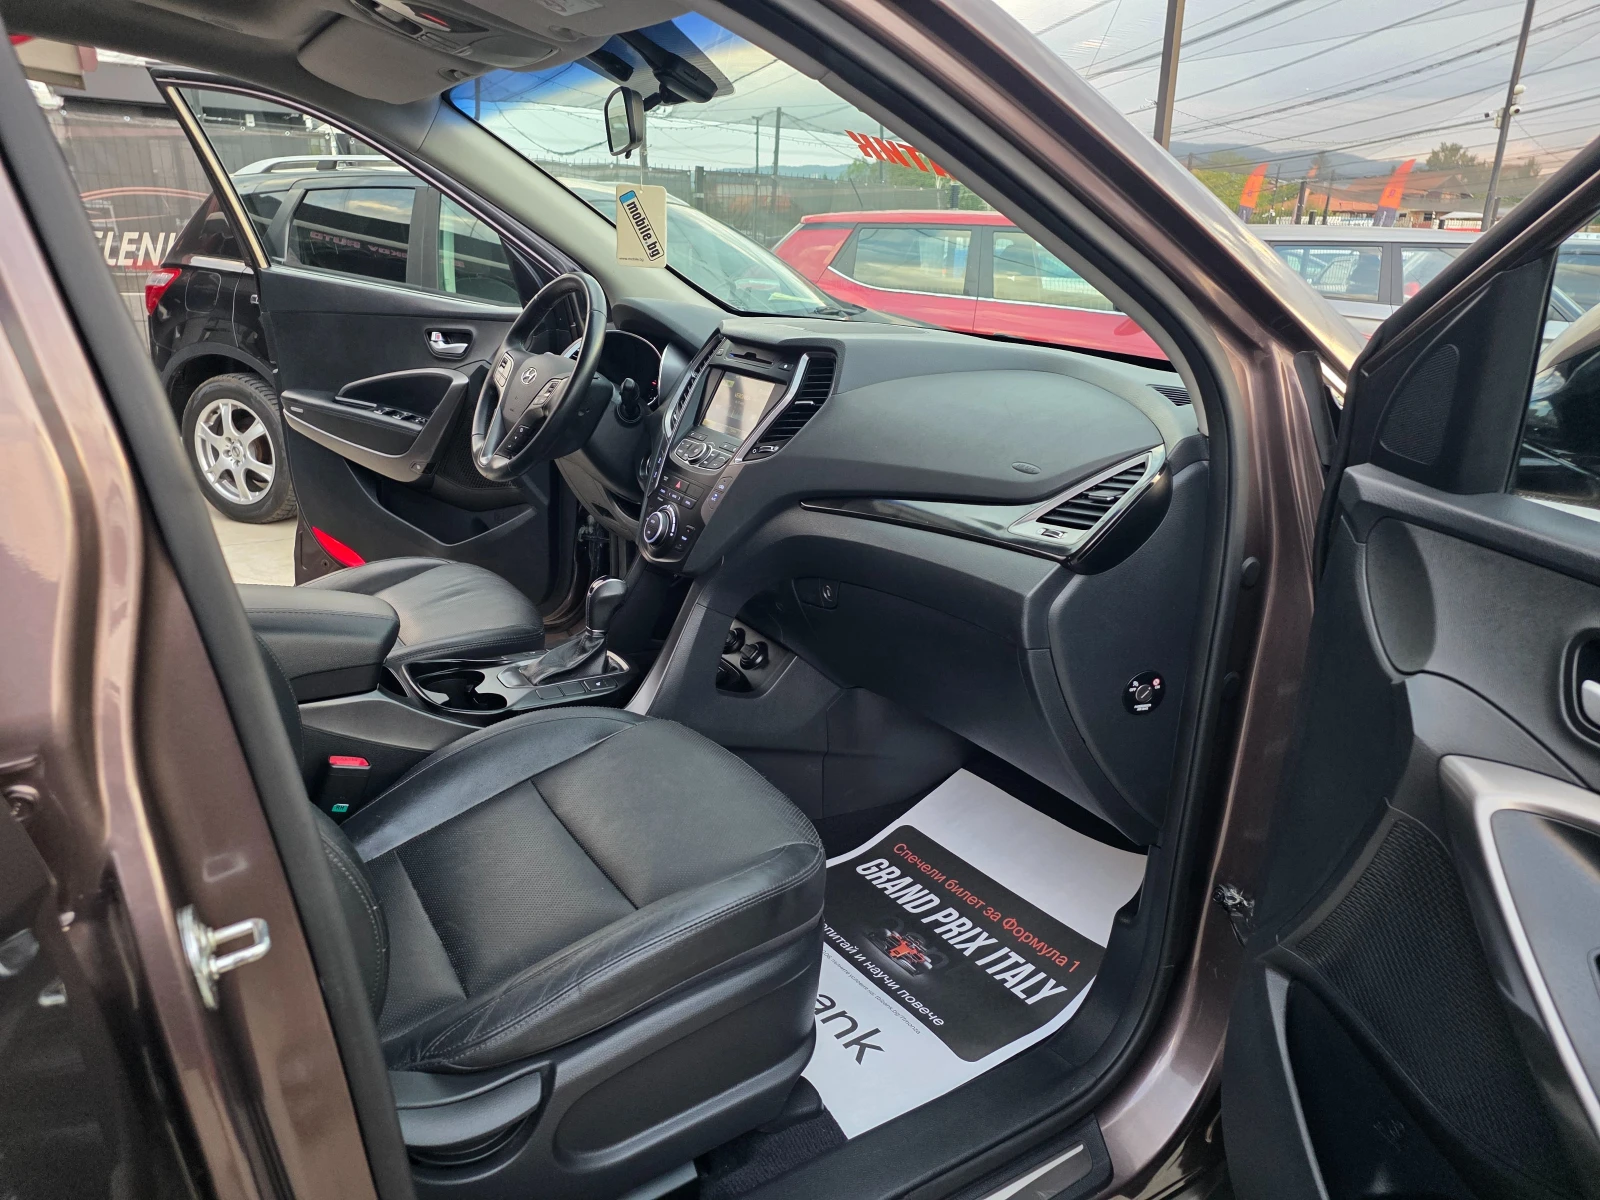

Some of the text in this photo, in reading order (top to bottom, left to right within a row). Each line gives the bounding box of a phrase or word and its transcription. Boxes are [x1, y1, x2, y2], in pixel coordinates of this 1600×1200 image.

[93, 231, 176, 266] LEN
[626, 201, 660, 258] mobile.bg
[856, 858, 1067, 1005] GRAND PRIX ITALY
[893, 843, 1081, 973] Спечели билет за Формула 1
[854, 953, 867, 962] и
[863, 961, 901, 990] научи
[897, 990, 945, 1026] повече
[814, 993, 885, 1066] ank
